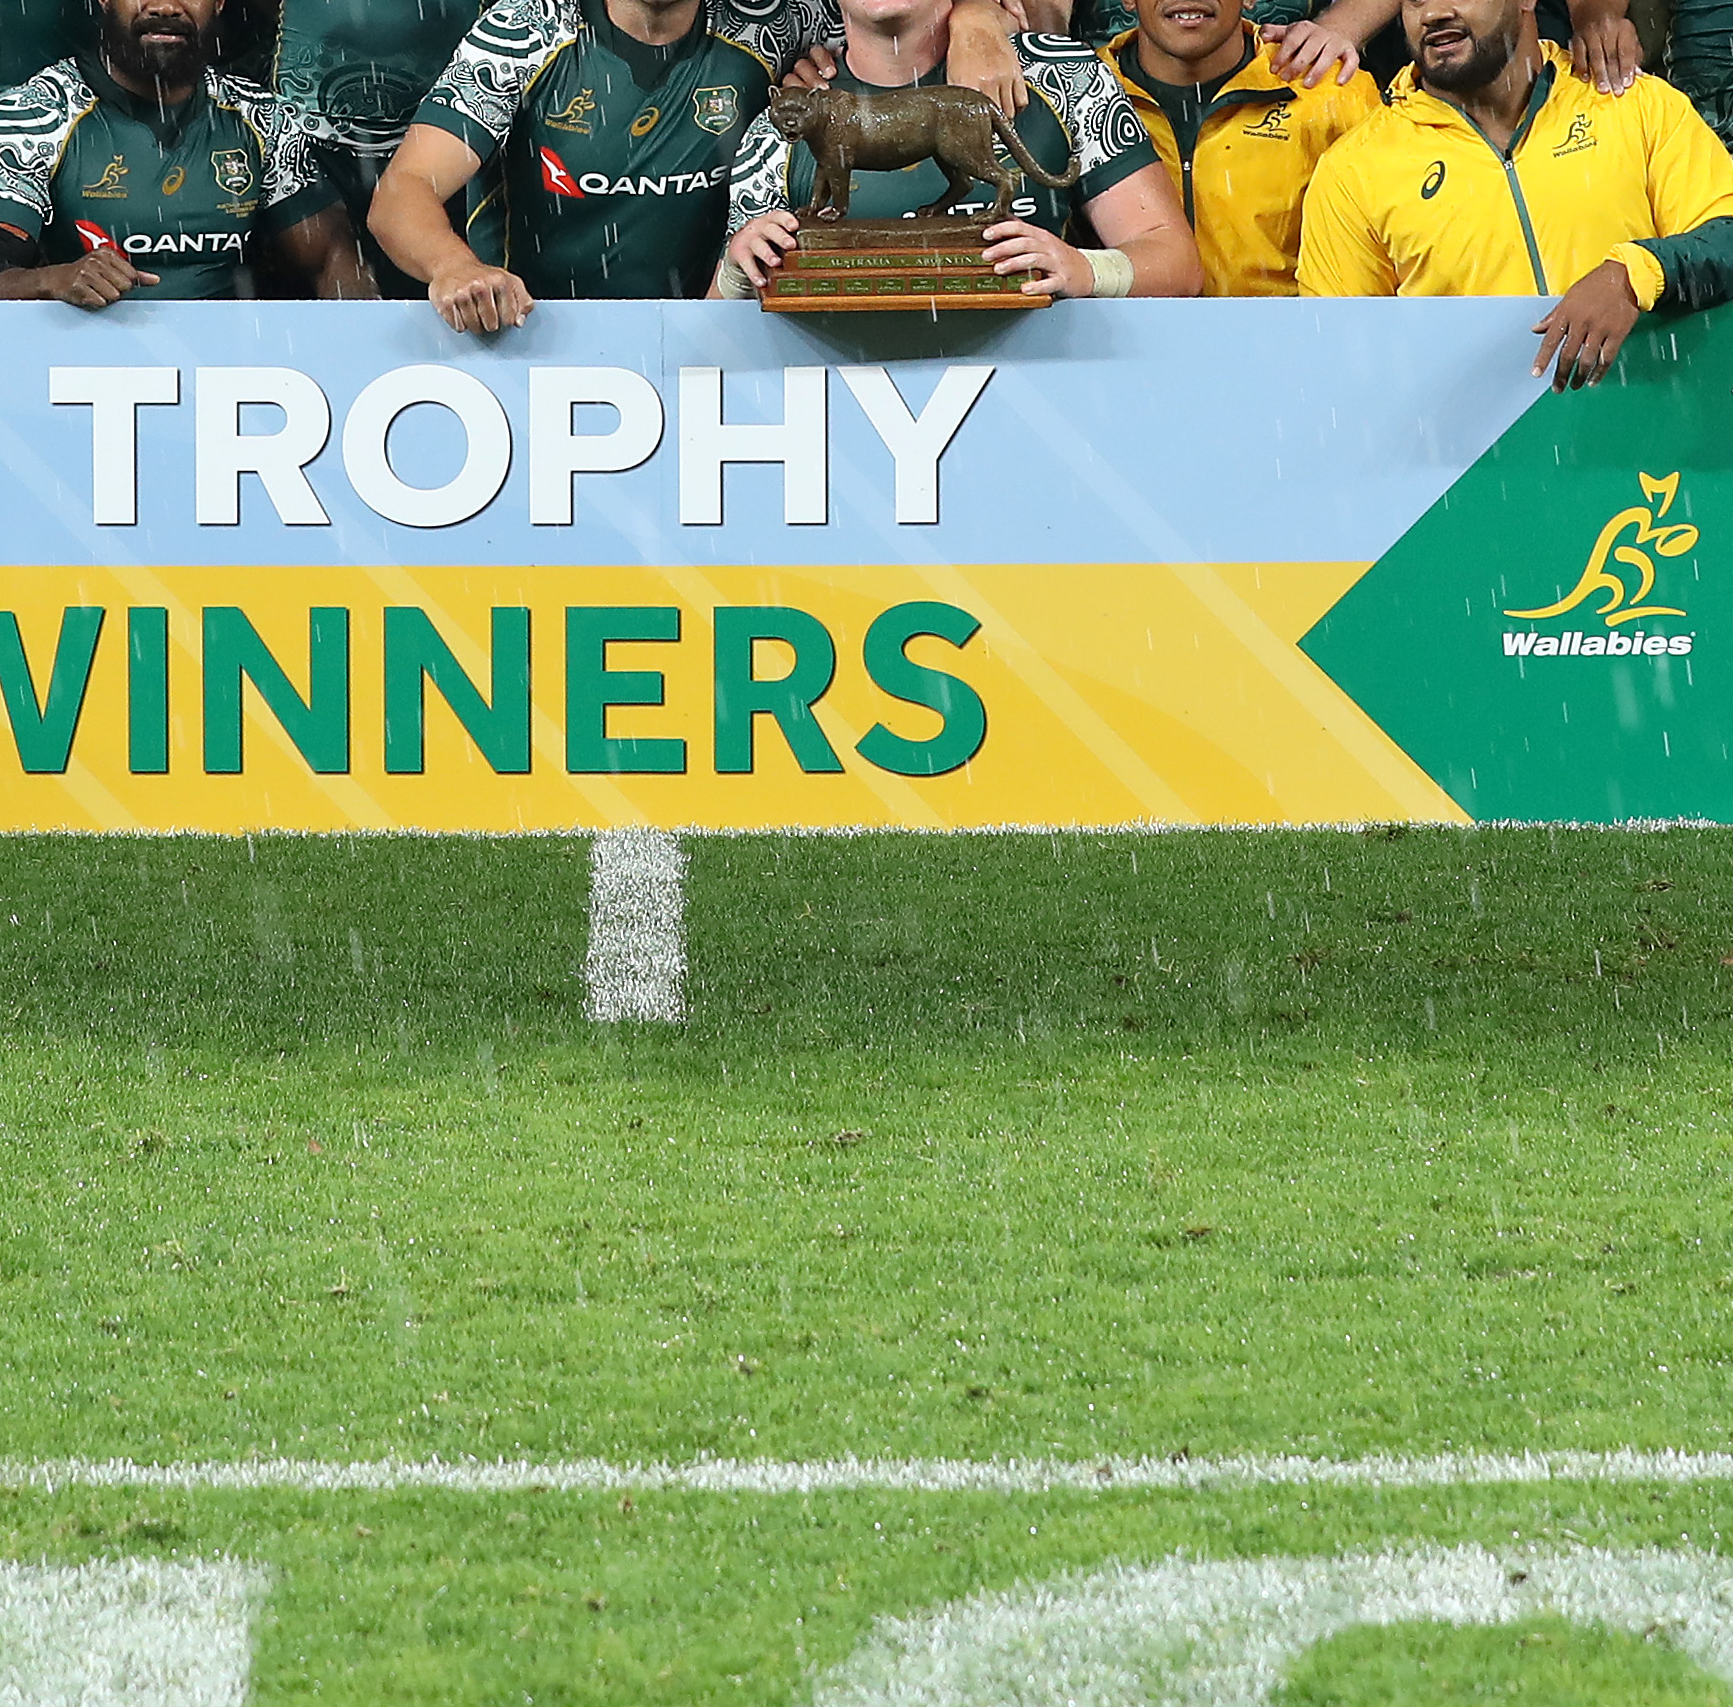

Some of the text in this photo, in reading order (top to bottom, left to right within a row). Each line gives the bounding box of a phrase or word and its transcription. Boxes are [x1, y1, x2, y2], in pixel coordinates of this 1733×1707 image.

[1243, 129, 1291, 142] Wallabies
[1552, 140, 1598, 158] Wallabies
[579, 165, 727, 196] QANTAS
[49, 364, 996, 527] TROPHY
